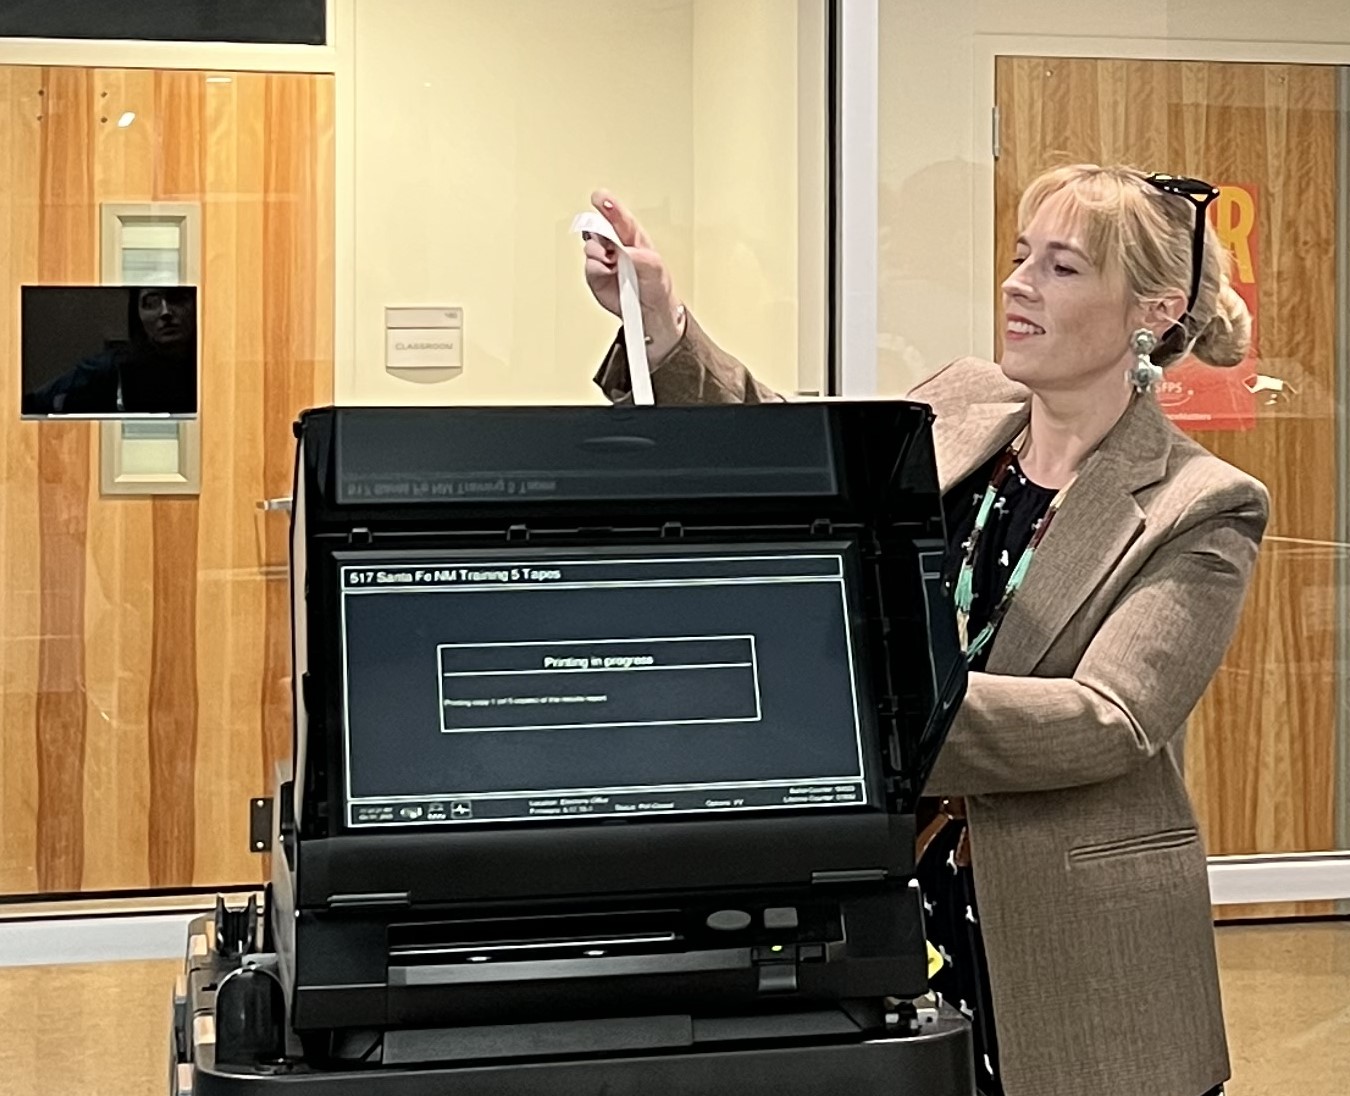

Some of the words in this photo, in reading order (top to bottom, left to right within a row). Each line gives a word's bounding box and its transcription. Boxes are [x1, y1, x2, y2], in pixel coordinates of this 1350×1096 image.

[395, 342, 454, 351] CLASSROOM
[349, 572, 374, 585] 517
[376, 571, 413, 584] Santa
[415, 570, 432, 583] Fe
[433, 570, 457, 583] NM
[458, 569, 509, 583] Training
[510, 568, 520, 582] 5
[522, 567, 561, 582] Tapes
[544, 656, 588, 669] Printing
[591, 656, 602, 667] in
[604, 655, 654, 670] progress
